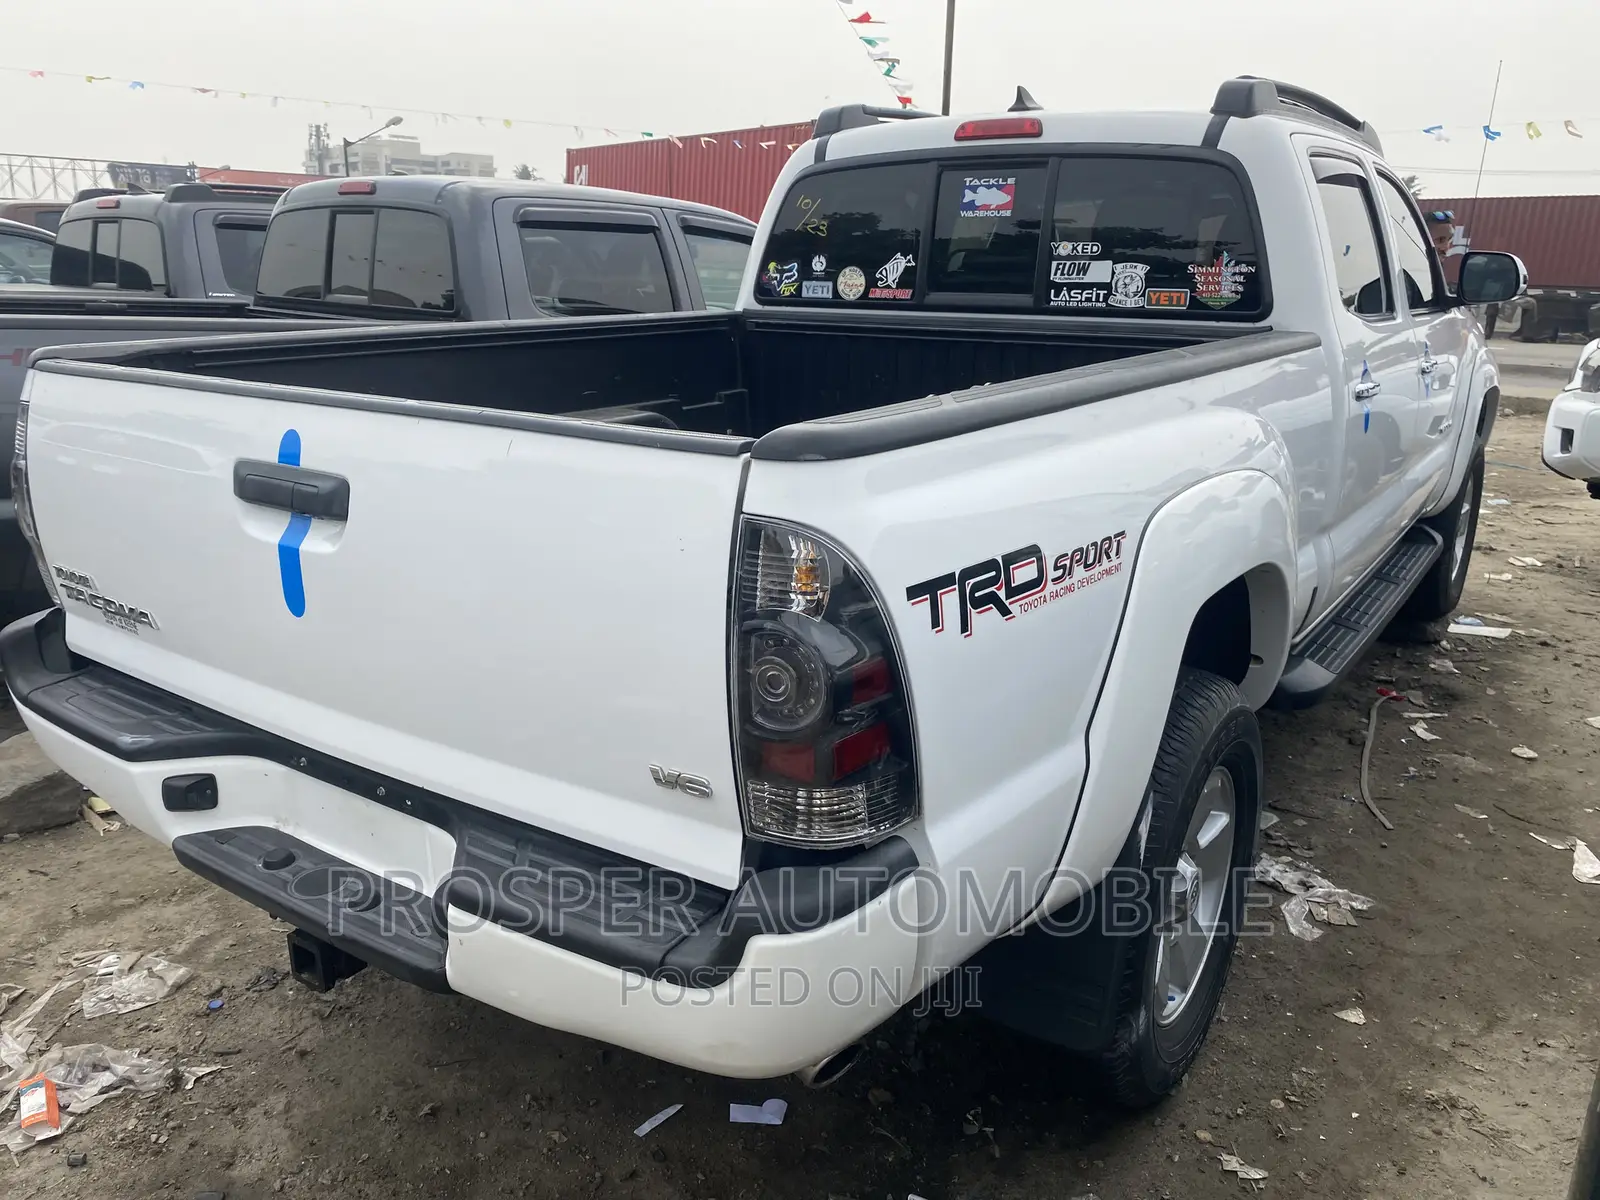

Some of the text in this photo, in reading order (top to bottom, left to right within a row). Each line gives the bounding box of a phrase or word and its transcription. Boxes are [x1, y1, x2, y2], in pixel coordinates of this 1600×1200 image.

[964, 177, 1016, 186] TACKLE
[1053, 262, 1092, 276] FLOW
[1194, 273, 1247, 283] SEASONAL
[804, 284, 830, 295] YETI
[1196, 282, 1244, 292] SERVICES
[1149, 292, 1185, 305] YETI
[906, 530, 1127, 638] TRD SPORT
[1018, 562, 1122, 614] TOYOTA RACING DEVELOPMENT
[649, 764, 713, 799] V6
